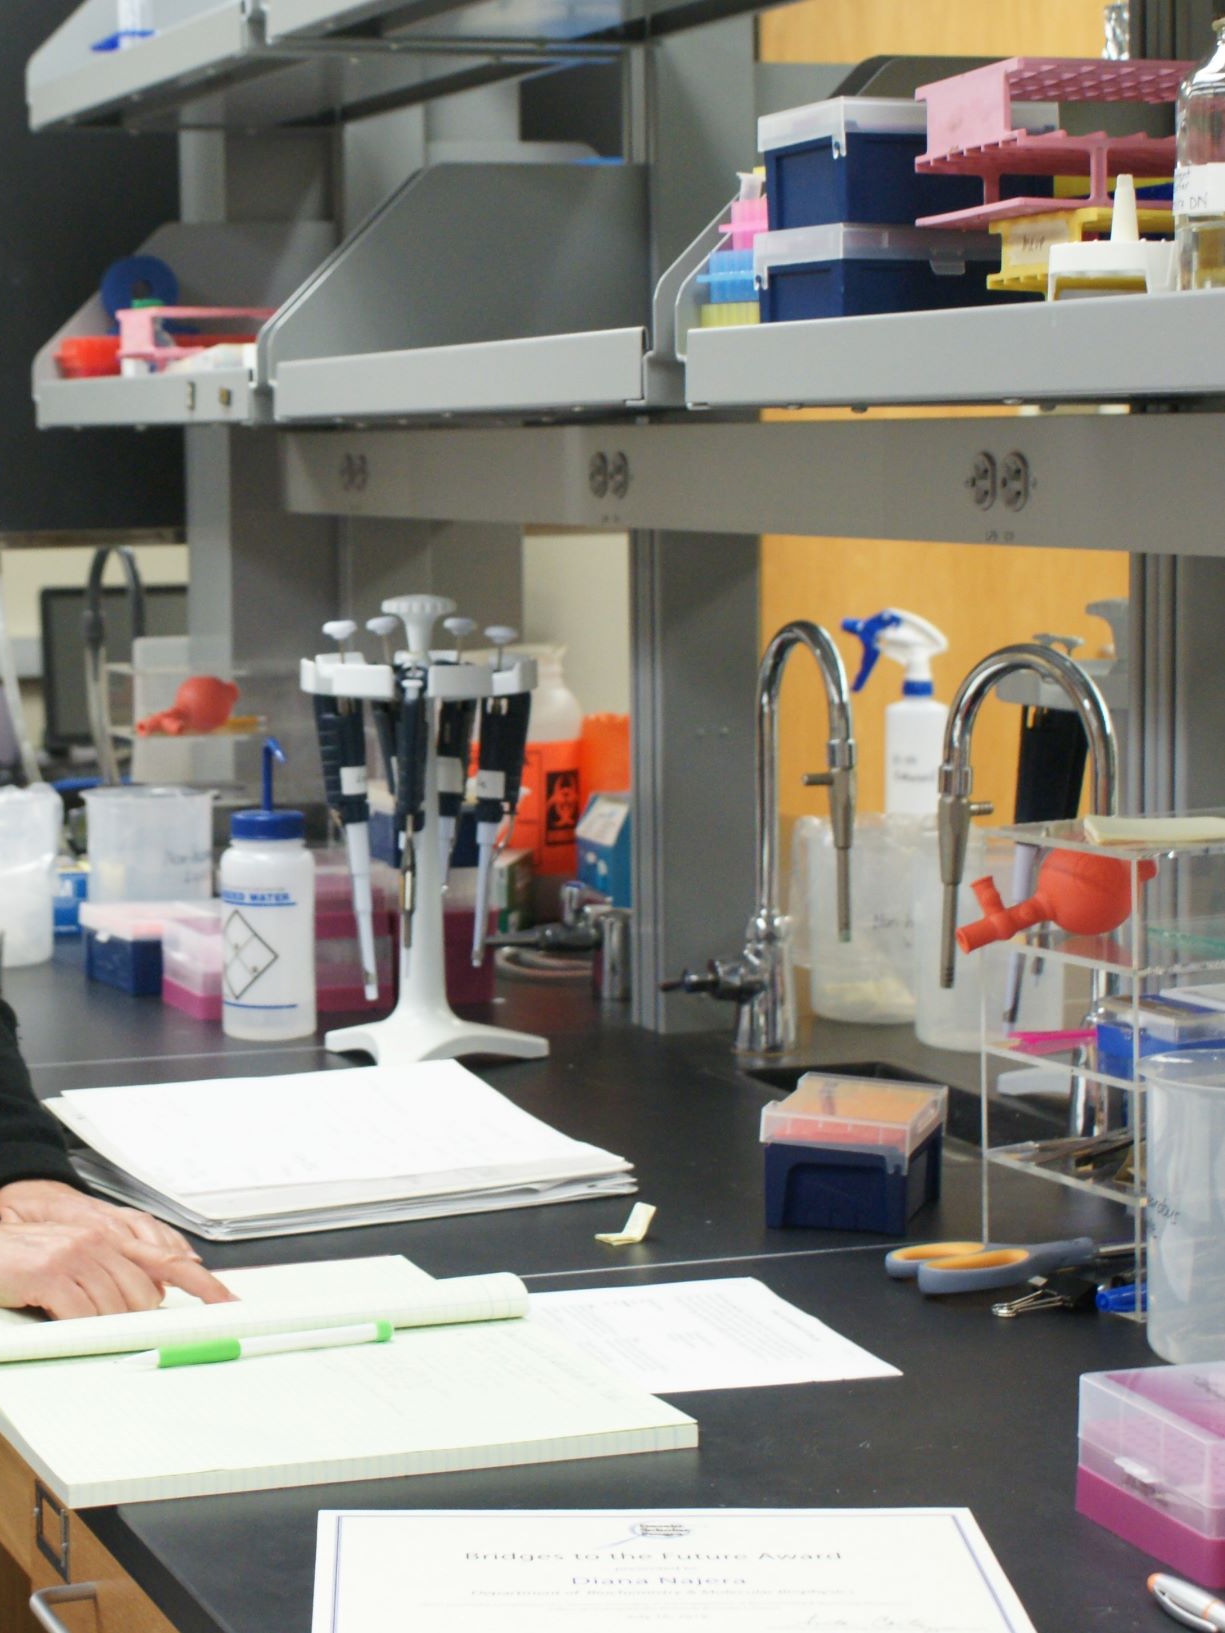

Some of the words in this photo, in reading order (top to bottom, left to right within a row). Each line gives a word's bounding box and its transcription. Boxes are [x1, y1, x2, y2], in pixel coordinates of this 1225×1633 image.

[249, 892, 289, 901] WATER
[465, 1552, 564, 1562] Bridges
[575, 1552, 600, 1560] to
[611, 1552, 653, 1560] the
[662, 1552, 747, 1560] Future
[759, 1552, 842, 1560] Award
[571, 1577, 649, 1585] Diana
[659, 1577, 747, 1586] Najera
